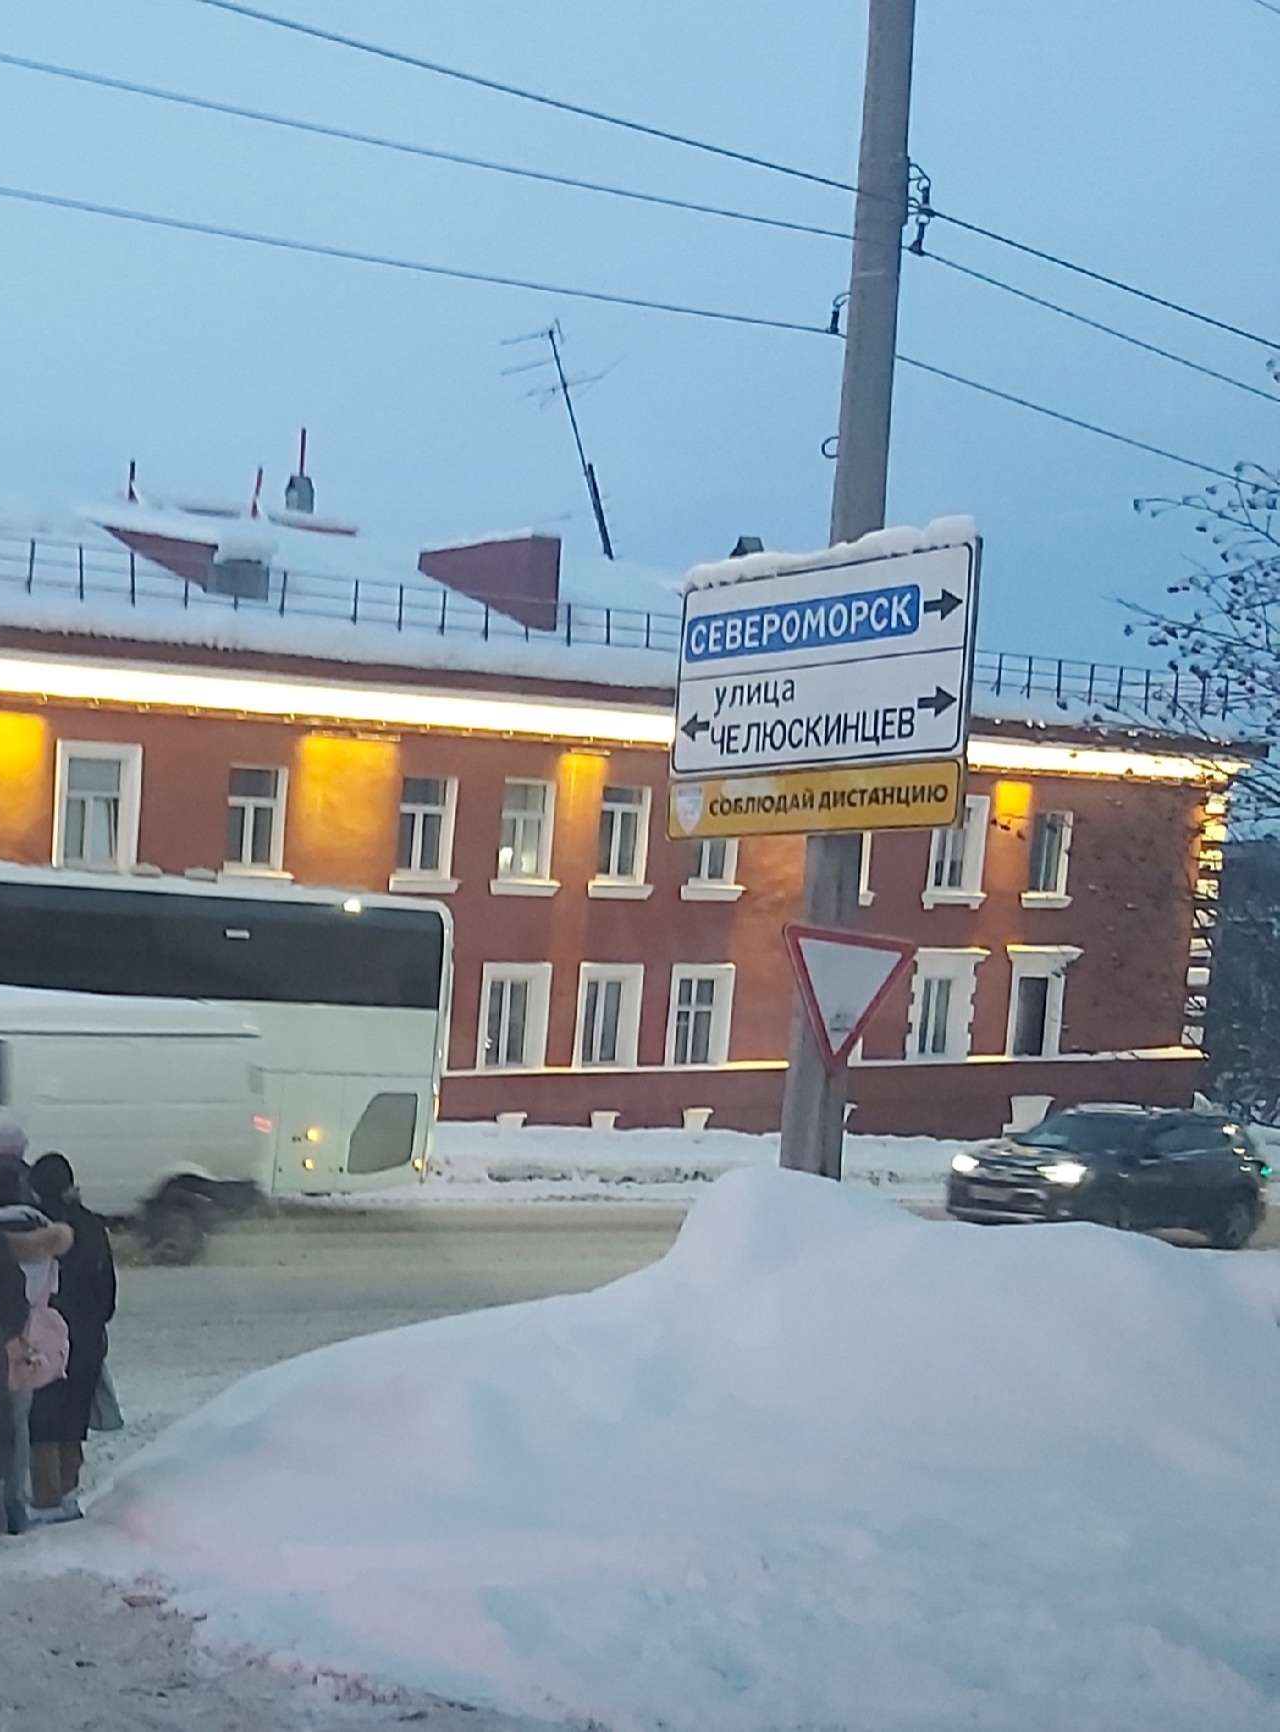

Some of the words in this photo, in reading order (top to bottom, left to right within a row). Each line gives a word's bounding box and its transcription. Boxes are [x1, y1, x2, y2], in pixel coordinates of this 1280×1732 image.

[690, 592, 913, 656] СЕВЕРОМОРСК
[713, 679, 796, 718] улица
[710, 706, 916, 756] ЧЕЛЮСКИНЦЕВ
[708, 789, 815, 817] СОБЛЮДАЙ
[819, 784, 949, 811] ДИСТАНЦИЮ
